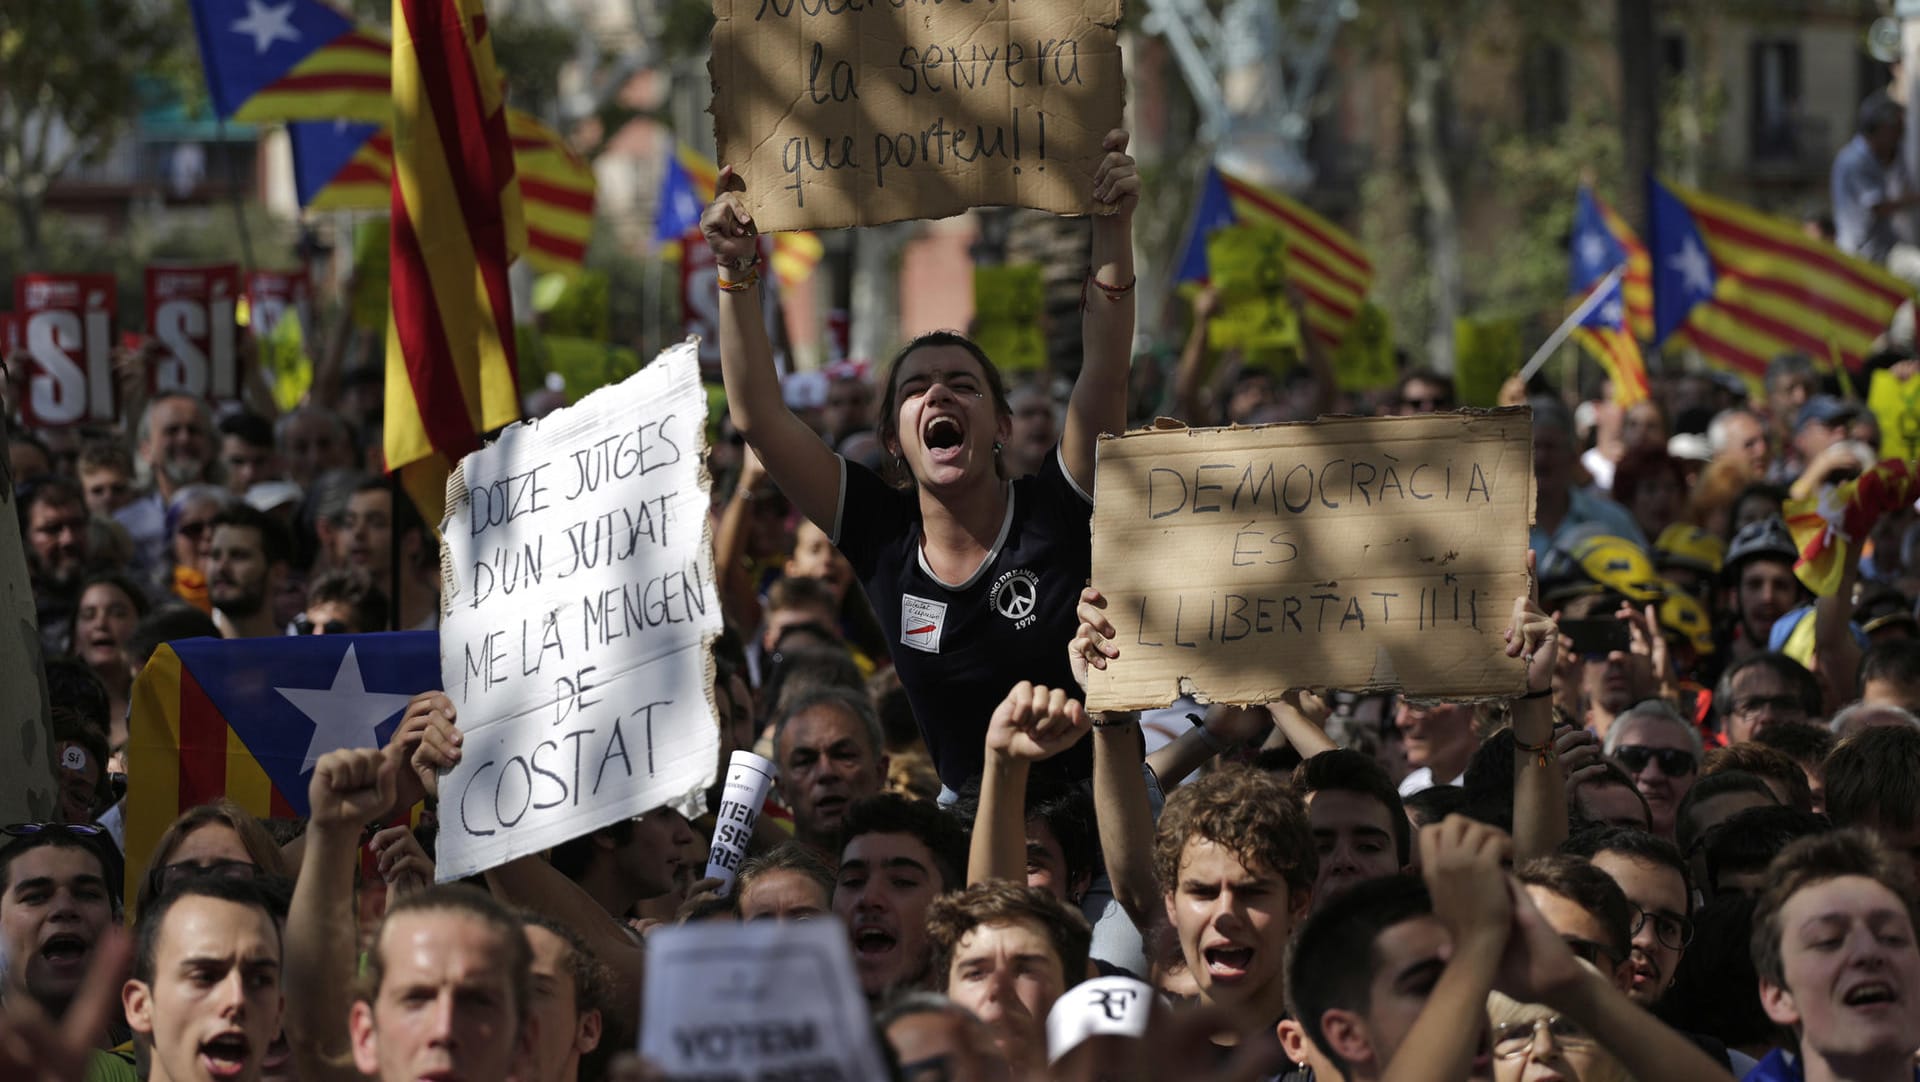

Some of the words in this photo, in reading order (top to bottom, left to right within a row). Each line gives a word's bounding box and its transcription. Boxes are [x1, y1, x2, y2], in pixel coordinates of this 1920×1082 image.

[809, 42, 859, 104] la
[781, 135, 861, 208] que
[26, 288, 114, 424] SÍ
[155, 277, 238, 400] SÍ
[566, 414, 681, 500] JUTGES
[470, 534, 543, 609] D'UN
[1232, 519, 1299, 566] ÉS
[464, 630, 508, 704] ME
[522, 609, 565, 677] LA
[583, 561, 706, 651] MENGEN
[1014, 614, 1037, 630] 1970
[553, 666, 604, 726] DE
[461, 700, 675, 836] COSTAT
